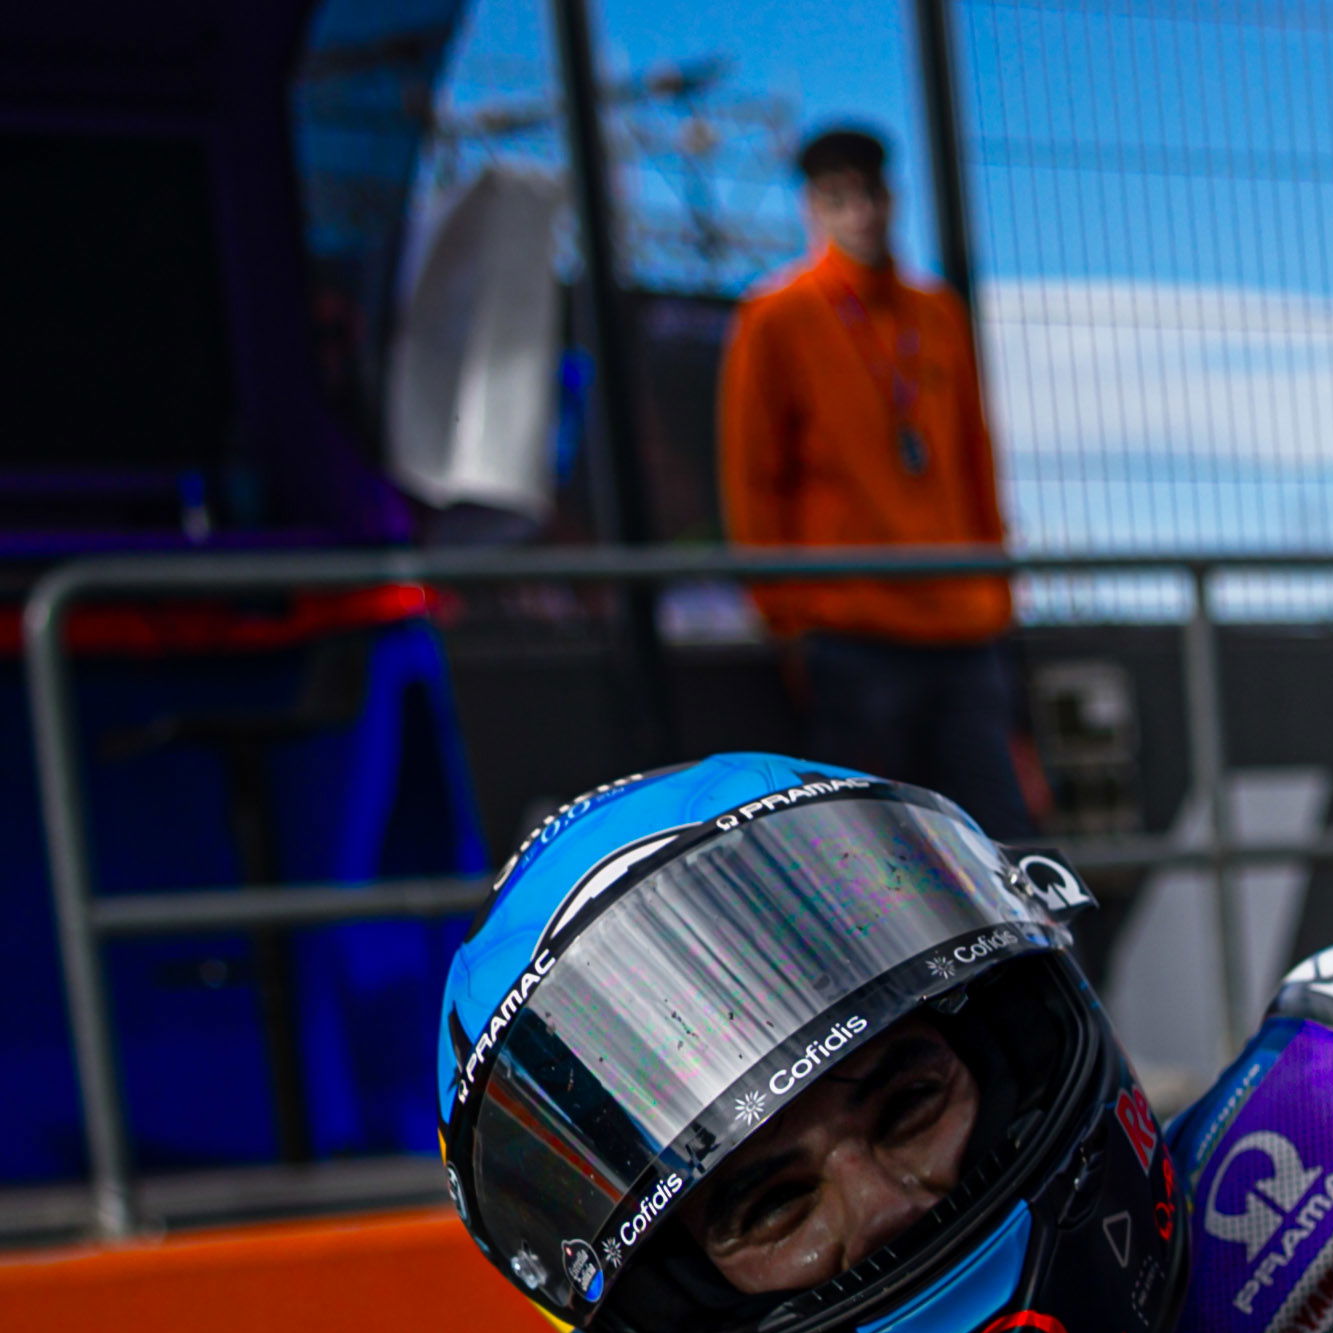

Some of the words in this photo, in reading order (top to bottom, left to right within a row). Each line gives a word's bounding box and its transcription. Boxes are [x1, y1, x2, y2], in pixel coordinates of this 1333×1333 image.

[738, 775, 870, 820] PRAMAC
[953, 928, 1019, 964] Cofidis
[465, 948, 556, 1082] PRAMAC
[769, 1015, 868, 1095] Cofidis
[619, 1172, 684, 1246] Cofidis
